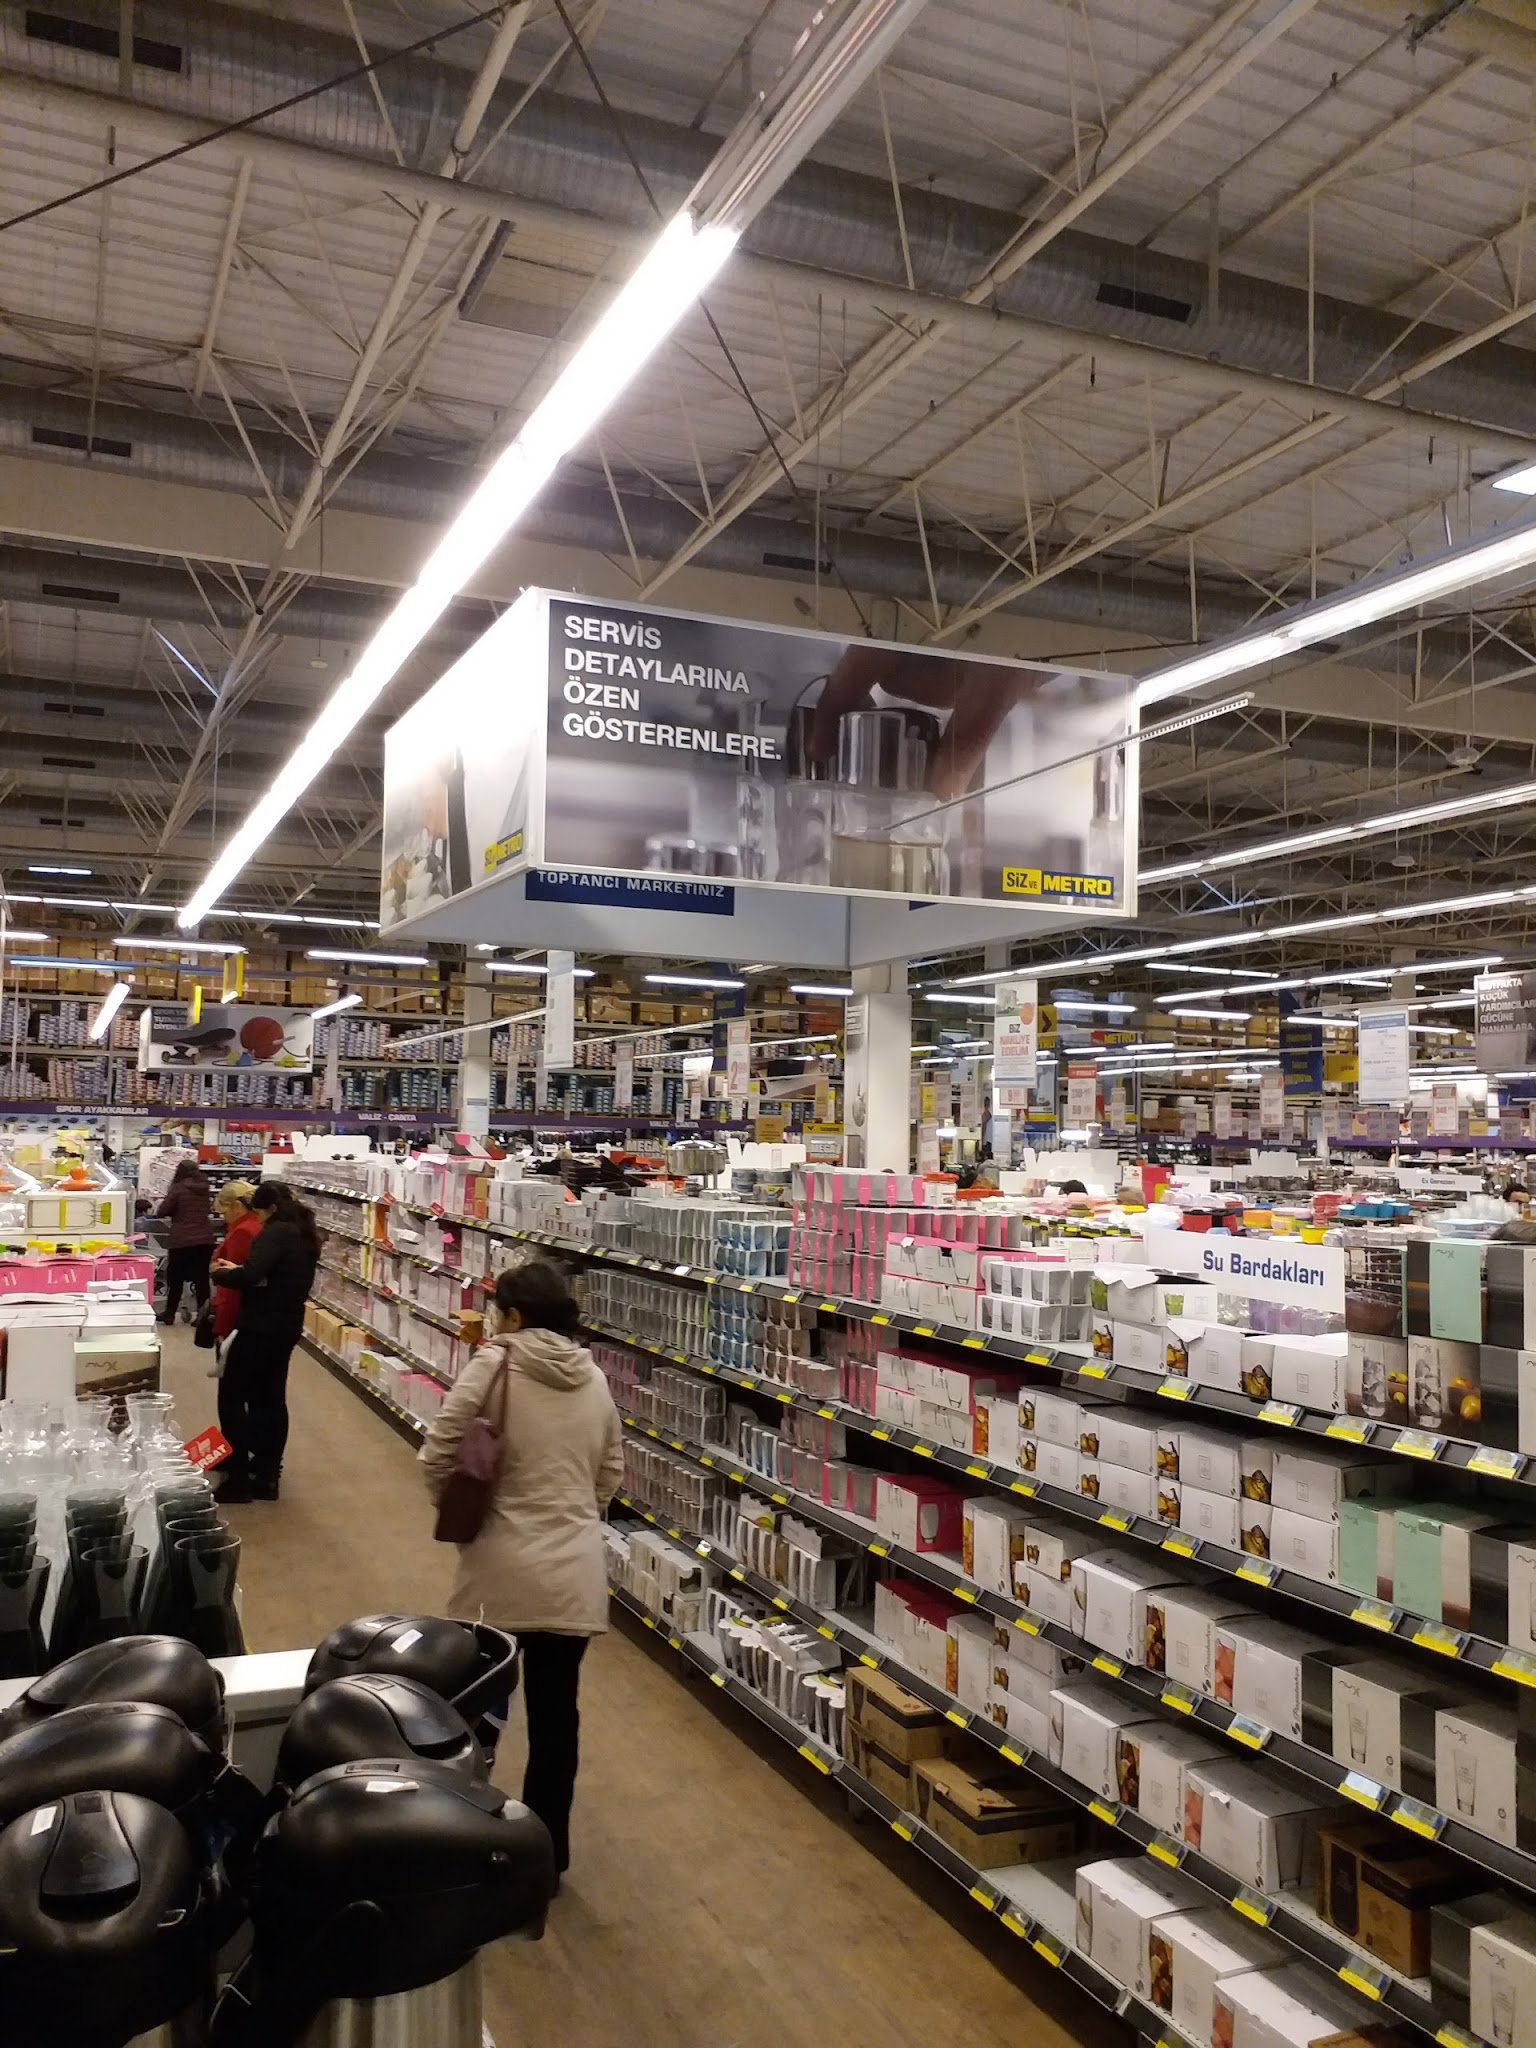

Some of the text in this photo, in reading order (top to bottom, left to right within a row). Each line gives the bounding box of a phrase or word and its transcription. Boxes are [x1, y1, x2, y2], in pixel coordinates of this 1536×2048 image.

[564, 615, 662, 650] SERVİS
[564, 647, 750, 694] DETAYLARINA
[563, 675, 639, 711] ÖZEN
[563, 710, 782, 761] GÖSTERENLERE.
[537, 870, 620, 889] TOPTANCI
[1043, 874, 1112, 896] METRO
[56, 1105, 149, 1115] SPOR AYAKKABILAR
[219, 1132, 260, 1146] MEGA
[1203, 1250, 1324, 1286] Su Bardakları
